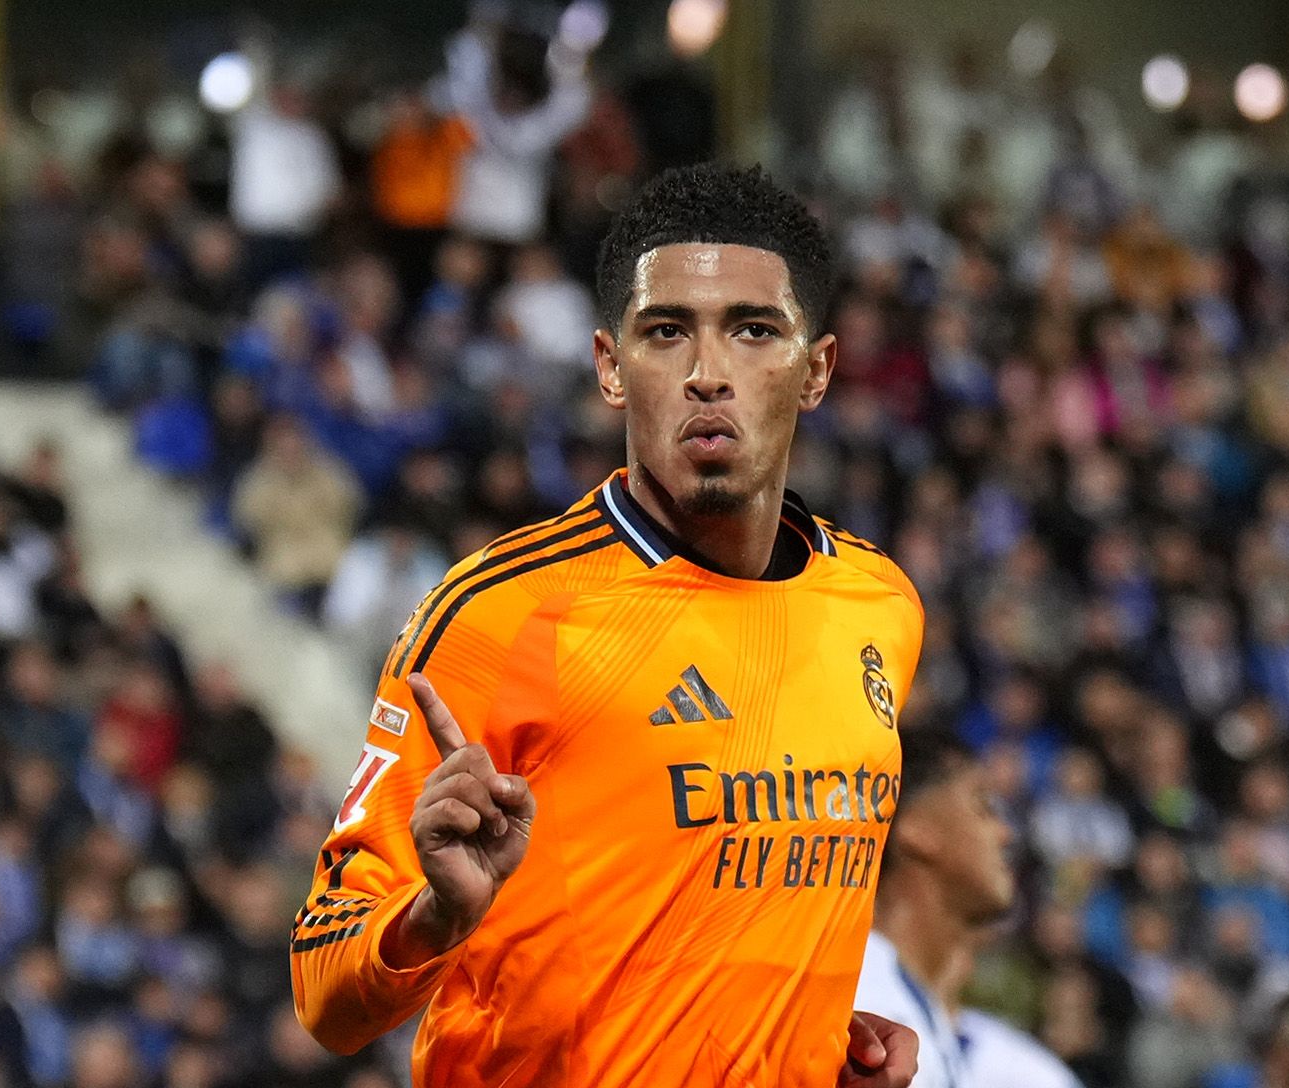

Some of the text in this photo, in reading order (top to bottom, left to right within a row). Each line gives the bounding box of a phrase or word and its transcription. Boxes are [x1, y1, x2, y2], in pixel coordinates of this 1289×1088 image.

[666, 753, 900, 829] Emirates
[713, 835, 876, 889] FLY BETTER
